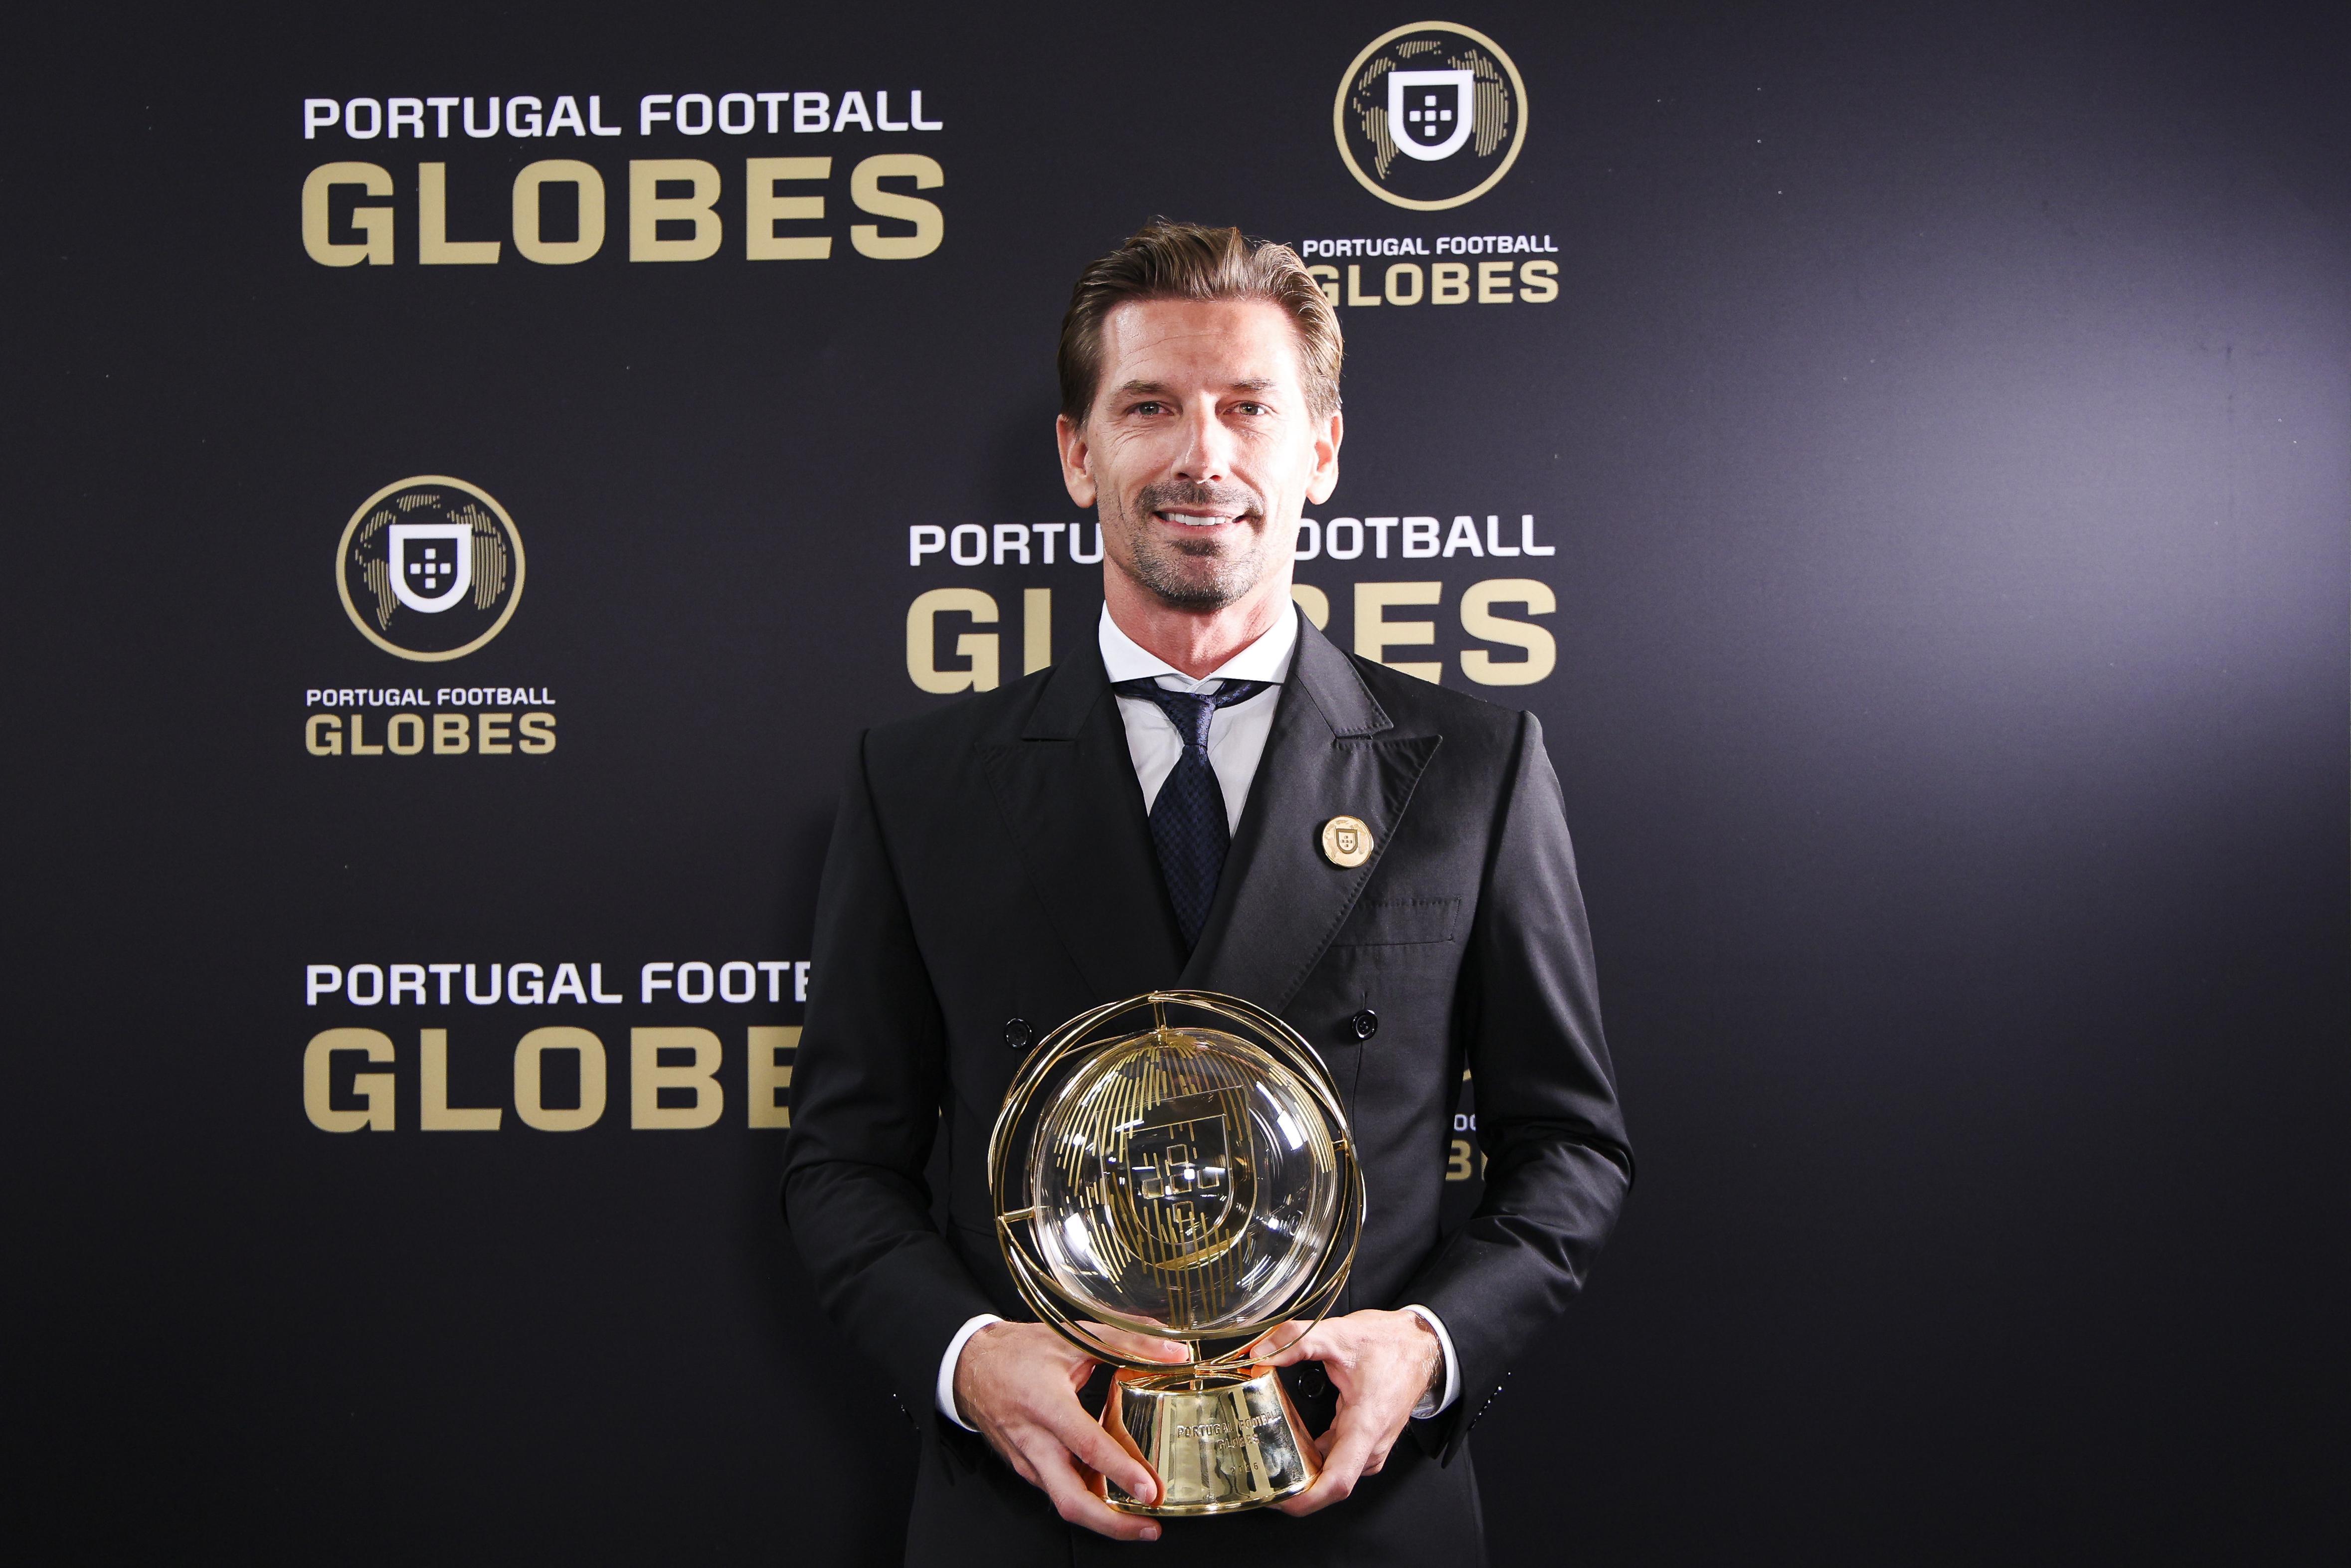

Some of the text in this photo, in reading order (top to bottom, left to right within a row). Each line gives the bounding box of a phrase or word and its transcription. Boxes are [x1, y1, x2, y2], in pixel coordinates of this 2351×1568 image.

[304, 90, 944, 140] PORTUGAL FOOTBALL
[302, 154, 944, 268] GLOBES
[1302, 235, 1559, 258] PORTUGAL FOOTBALL
[1307, 260, 1560, 307] GLOBES
[910, 515, 1557, 566] PORTU OOTBALL
[306, 688, 556, 707] PORTUGAL FOOTBALL
[305, 712, 557, 756] GLOBES
[306, 963, 623, 1007] PORTUGAL
[304, 1026, 803, 1134] GLOBE
[1177, 1409, 1281, 1438] PORTUGAL FOOTBALL
[1218, 1432, 1260, 1450] GLOBES
